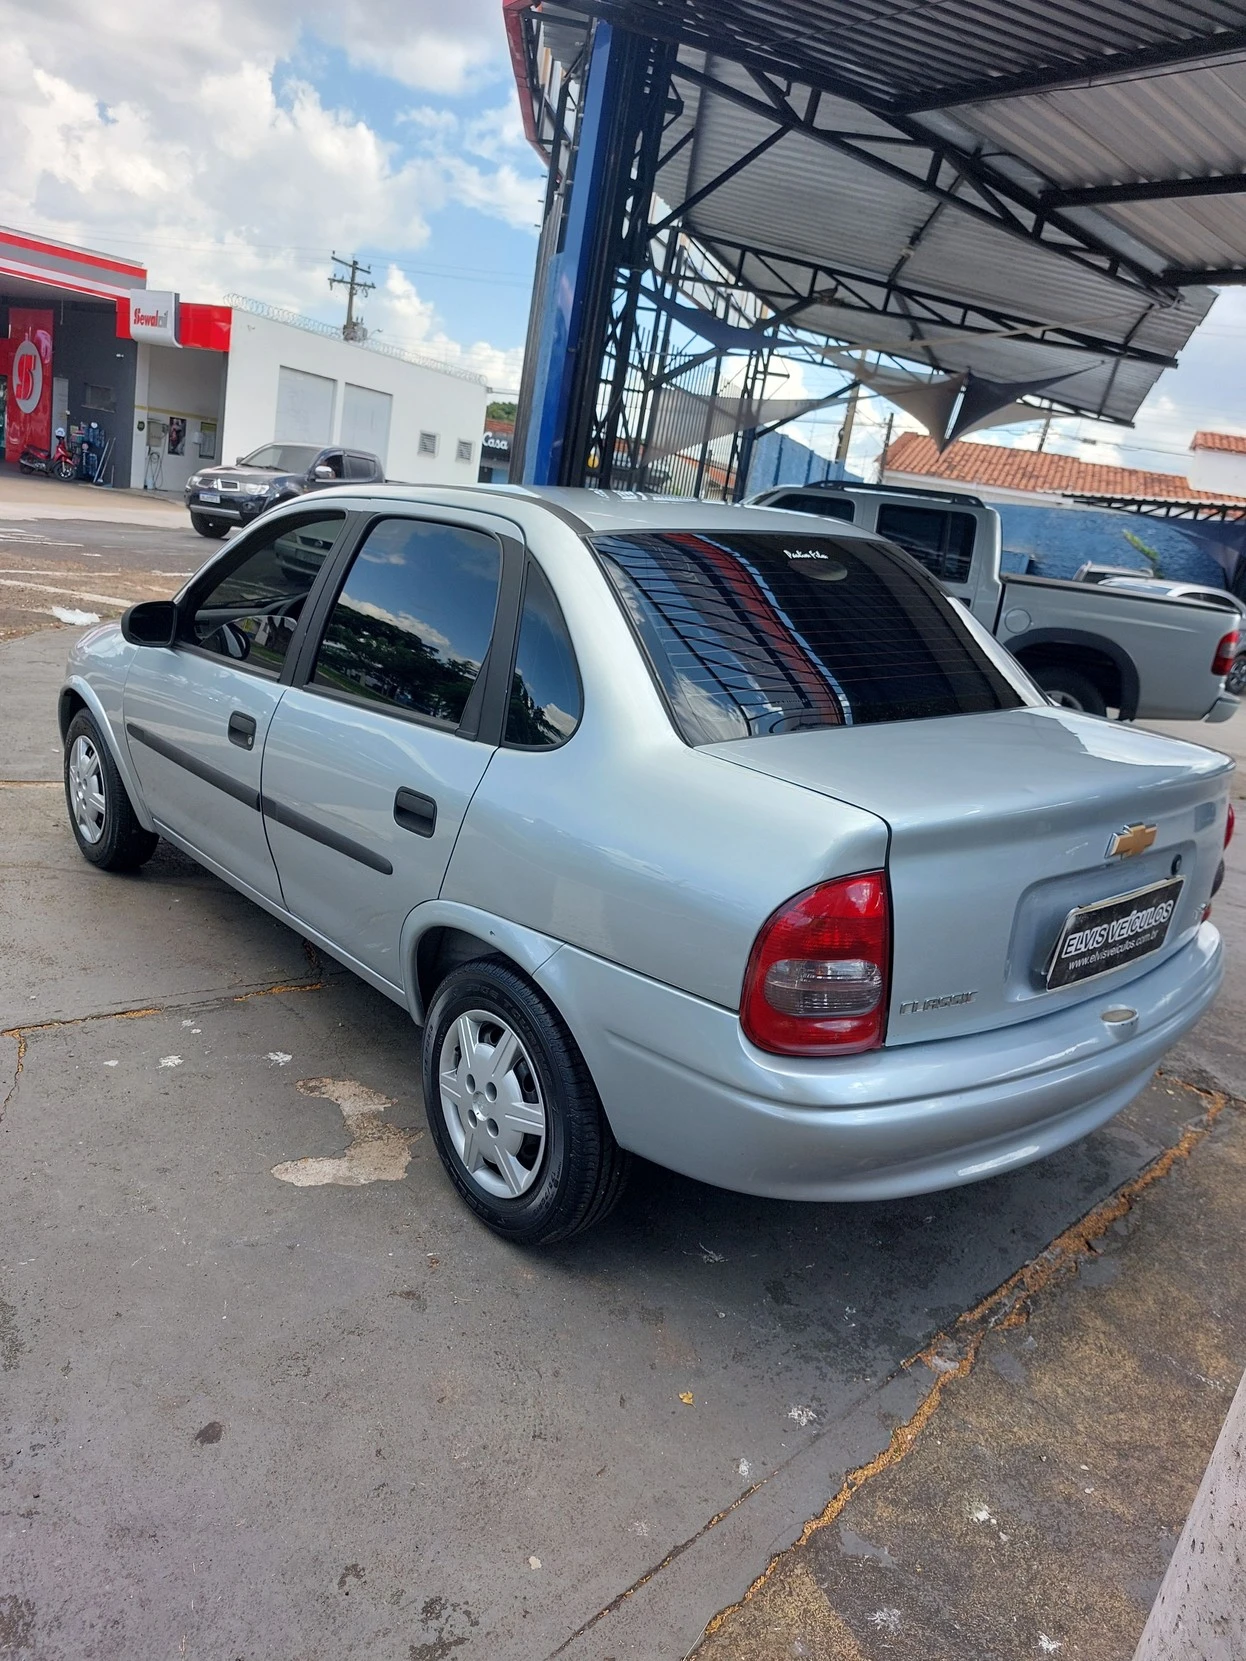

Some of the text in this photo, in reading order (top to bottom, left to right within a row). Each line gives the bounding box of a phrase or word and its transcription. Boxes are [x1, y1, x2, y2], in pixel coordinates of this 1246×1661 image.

[482, 431, 508, 450] Casa
[1061, 924, 1109, 958] ELVIS
[1068, 929, 1159, 970] www.elvisveiculos.com.br
